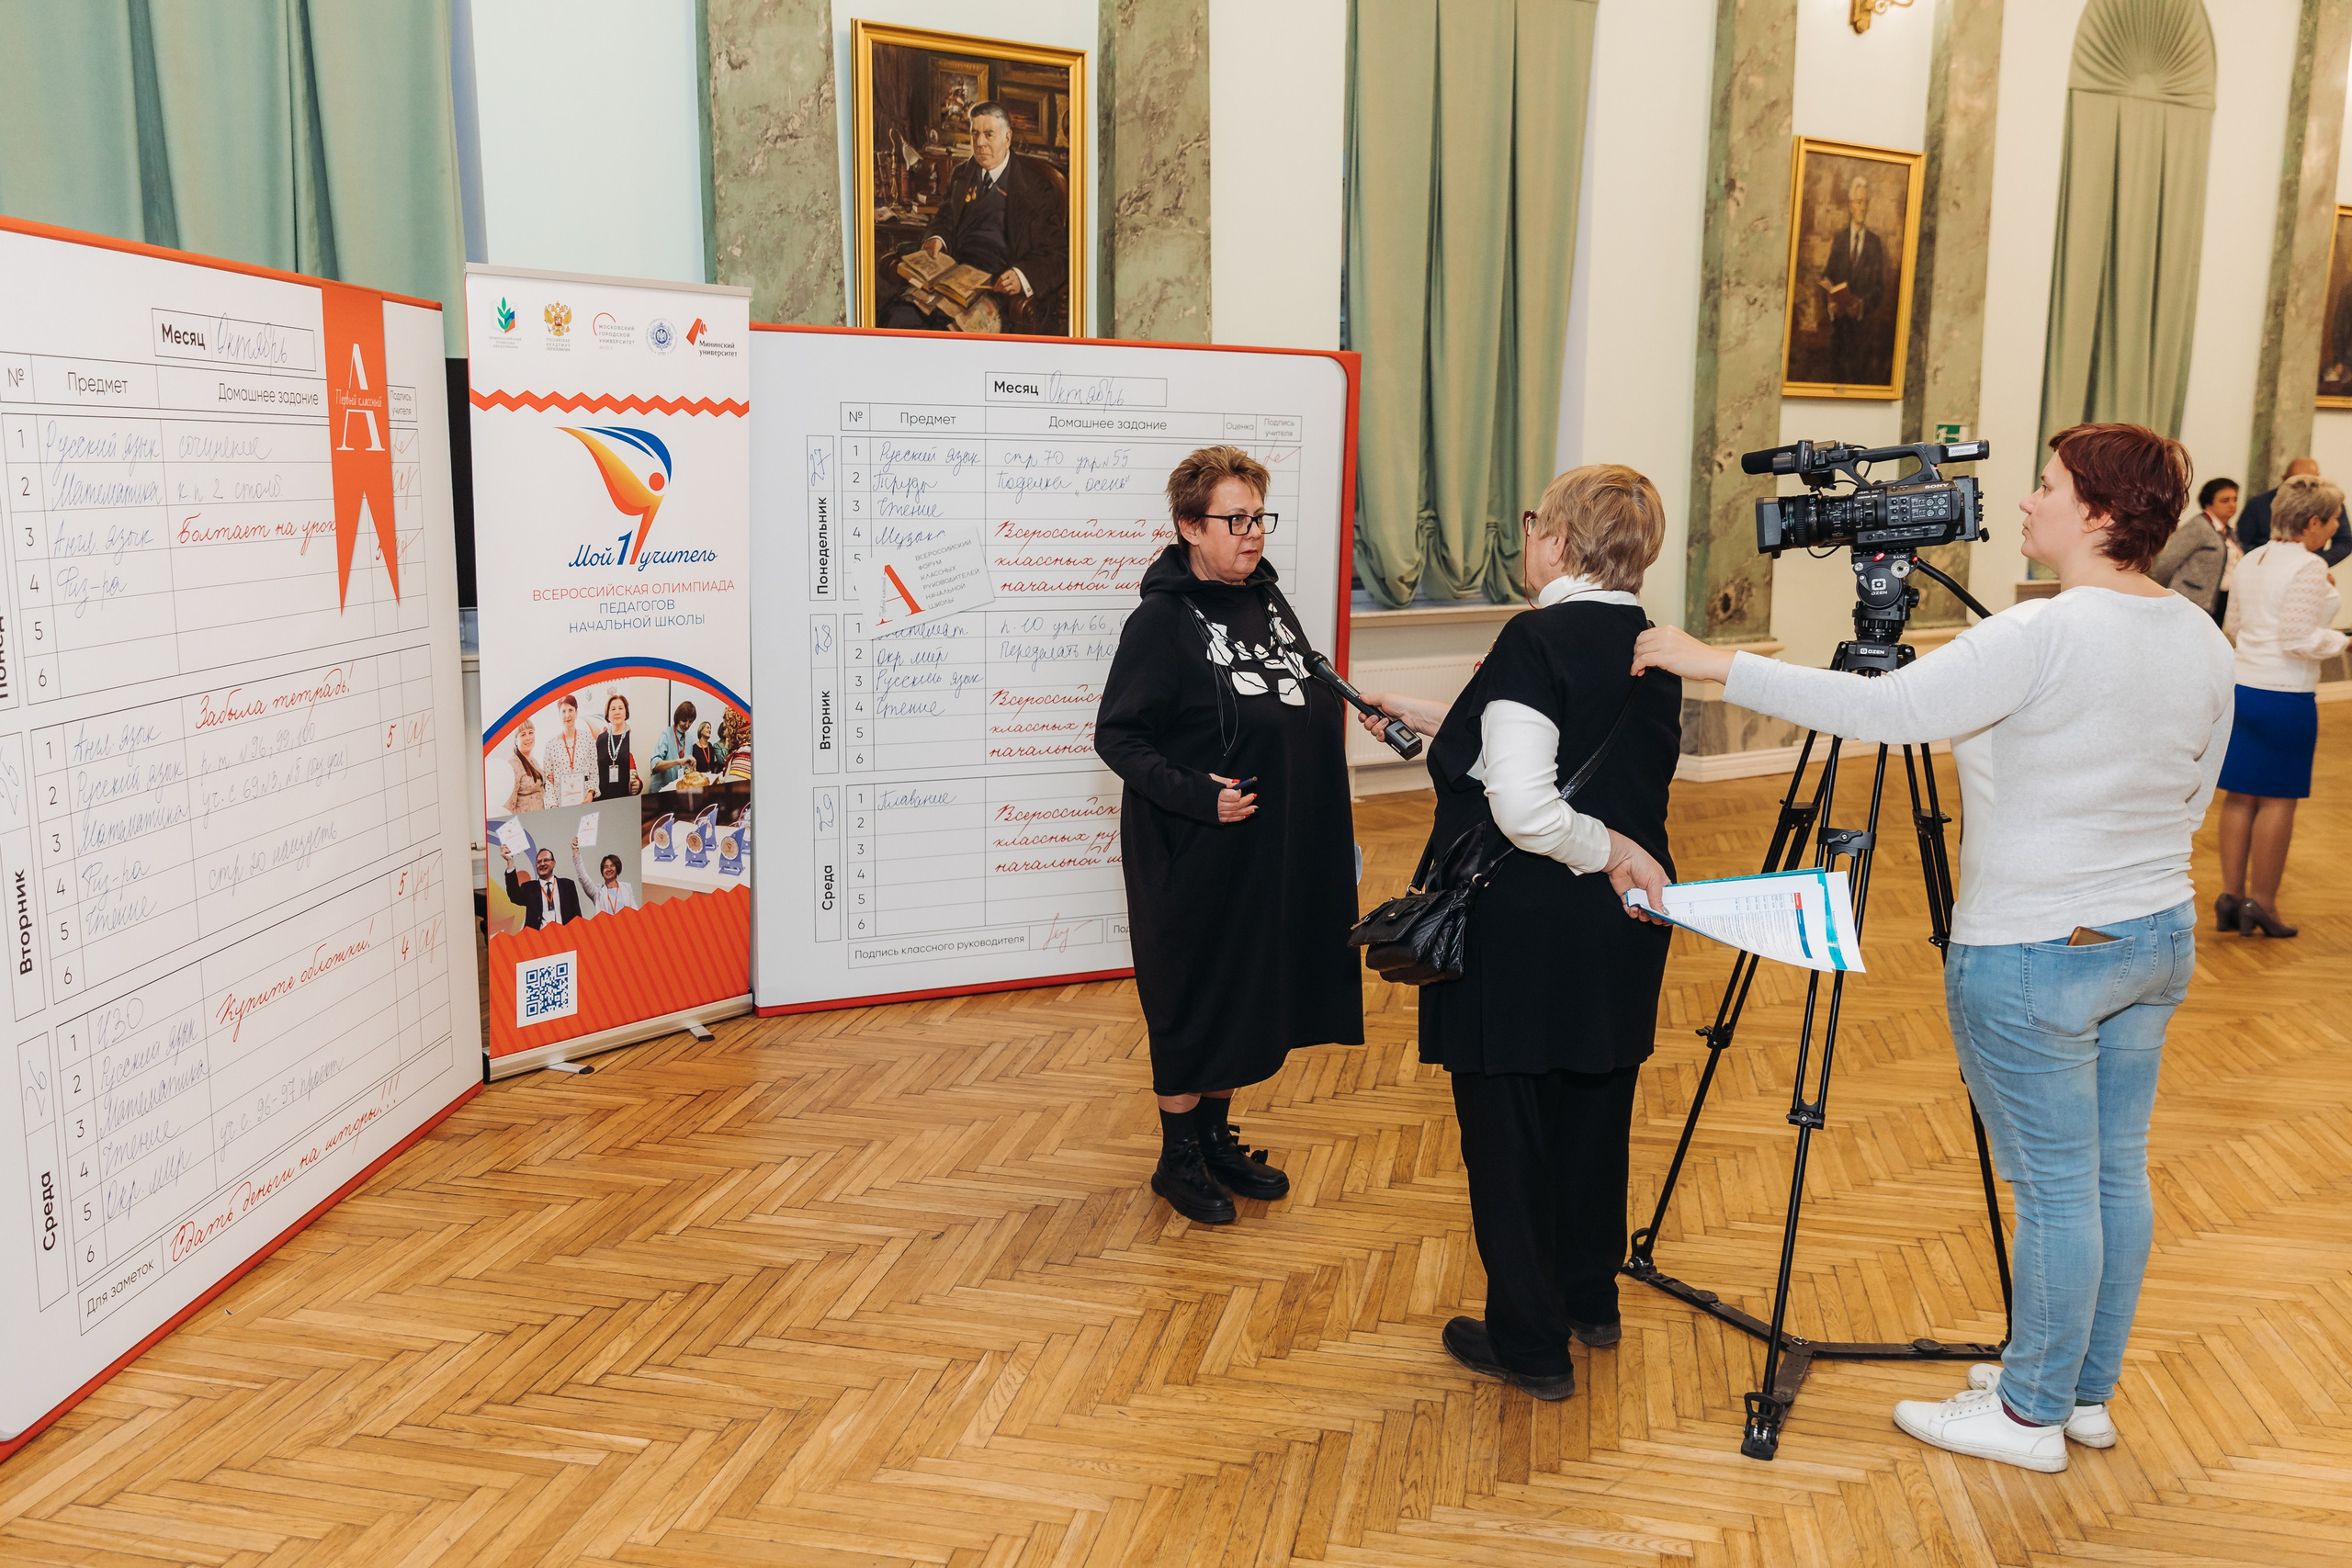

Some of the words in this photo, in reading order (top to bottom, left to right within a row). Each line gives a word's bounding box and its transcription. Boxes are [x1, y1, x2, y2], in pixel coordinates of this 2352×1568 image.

[161, 323, 206, 351] Месяц
[217, 312, 288, 378] Октябрь
[698, 340, 736, 349] Мининский
[698, 349, 738, 357] университет
[7, 367, 25, 388] №
[67, 371, 128, 396] Предмет
[218, 382, 276, 402] Домашнее
[277, 390, 319, 406] задание
[336, 343, 385, 451] А
[390, 389, 413, 401] Подпись
[993, 380, 1039, 397] Месяц
[1048, 369, 1125, 413] Октябрь
[335, 389, 357, 411] Первый
[357, 396, 382, 407] классный
[391, 406, 412, 416] учителя
[849, 411, 864, 423] №
[899, 412, 956, 426] Предмет
[1048, 415, 1114, 429] Домашнее
[1117, 420, 1167, 431] задание
[1226, 422, 1254, 431] Оценка
[1263, 418, 1295, 427] Подпись
[17, 428, 25, 448] 1
[1265, 430, 1294, 438] учителя
[46, 420, 117, 487] Русский
[122, 433, 160, 477] язык
[853, 445, 858, 457] 1
[879, 440, 937, 473] Русский
[945, 447, 981, 477] язык
[21, 477, 30, 496] 2
[852, 471, 860, 483] 2
[51, 472, 163, 512] Математика
[852, 500, 860, 512] 3
[24, 527, 36, 547] 3
[176, 513, 271, 544] Болтает
[276, 522, 298, 536] на
[853, 526, 861, 538] 4
[994, 518, 1147, 555] Всероссийский
[106, 525, 154, 566] язык
[817, 497, 830, 594] Понедельник
[915, 539, 972, 561] ВСЕРОССИЙСКИЙ
[568, 544, 616, 568] Мой
[638, 548, 718, 572] учитель
[918, 559, 943, 570] ФОРУМ
[994, 555, 1097, 567] классных
[921, 565, 957, 581] КЛАССНЫХ
[922, 569, 980, 590] РУКОВОДИТЕЛЕЙ
[1000, 570, 1110, 592] начальной
[29, 574, 40, 594] 4
[532, 582, 649, 602] ВСЕРОССИЙСКАЯ
[651, 580, 735, 594] ОЛИМПИАДА
[925, 583, 967, 600] НАЧАЛЬНОЙ
[599, 599, 676, 615] ПЕДАГОГОВ
[928, 597, 955, 610] ШКОЛЫ
[34, 621, 43, 640] 5
[569, 615, 652, 634] НАЧАЛЬНОЙ
[654, 614, 706, 627] ШКОЛЫ
[855, 622, 861, 634] 1
[854, 648, 863, 660] 2
[39, 668, 47, 687] 6
[854, 675, 863, 687] 3
[950, 671, 984, 699] язык
[196, 688, 267, 729] Забыла
[272, 660, 355, 727] тетрадь!
[854, 701, 864, 713] 4
[820, 690, 833, 750] Вторник
[989, 721, 1080, 734] классных
[386, 723, 397, 749] 5
[855, 727, 864, 739] 5
[45, 741, 52, 760] 1
[119, 724, 162, 767] язык
[855, 753, 864, 764] 6
[147, 761, 185, 804] язык
[48, 786, 58, 806] 2
[857, 793, 863, 804] 1
[857, 817, 865, 829] 2
[51, 833, 62, 852] 3
[856, 844, 865, 855] 3
[992, 832, 1090, 848] классных
[994, 845, 1102, 873] начальной
[398, 870, 408, 897] 5
[857, 869, 865, 880] 4
[56, 877, 66, 896] 4
[821, 864, 836, 911] Среда
[857, 894, 865, 905] 5
[14, 869, 33, 975] Вторник
[60, 921, 69, 941] 5
[857, 919, 865, 930] 6
[401, 935, 409, 962] 4
[854, 948, 899, 960] Подпись
[901, 942, 955, 955] классного
[956, 935, 1025, 951] руководителя
[63, 965, 73, 985] 6
[215, 976, 296, 1043] Купите
[300, 916, 375, 983] обложки!
[97, 997, 145, 1050] ИЗО
[70, 1033, 77, 1052] 1
[73, 1075, 82, 1094] 2
[76, 1119, 85, 1138] 3
[80, 1161, 89, 1178] 4
[40, 1170, 59, 1251] Среда
[84, 1202, 92, 1222] 5
[169, 1205, 234, 1263] Сдать
[228, 1167, 296, 1212] деньги
[299, 1147, 322, 1169] на
[86, 1245, 96, 1263] 6
[86, 1292, 108, 1318] Для
[110, 1258, 155, 1298] заметок
